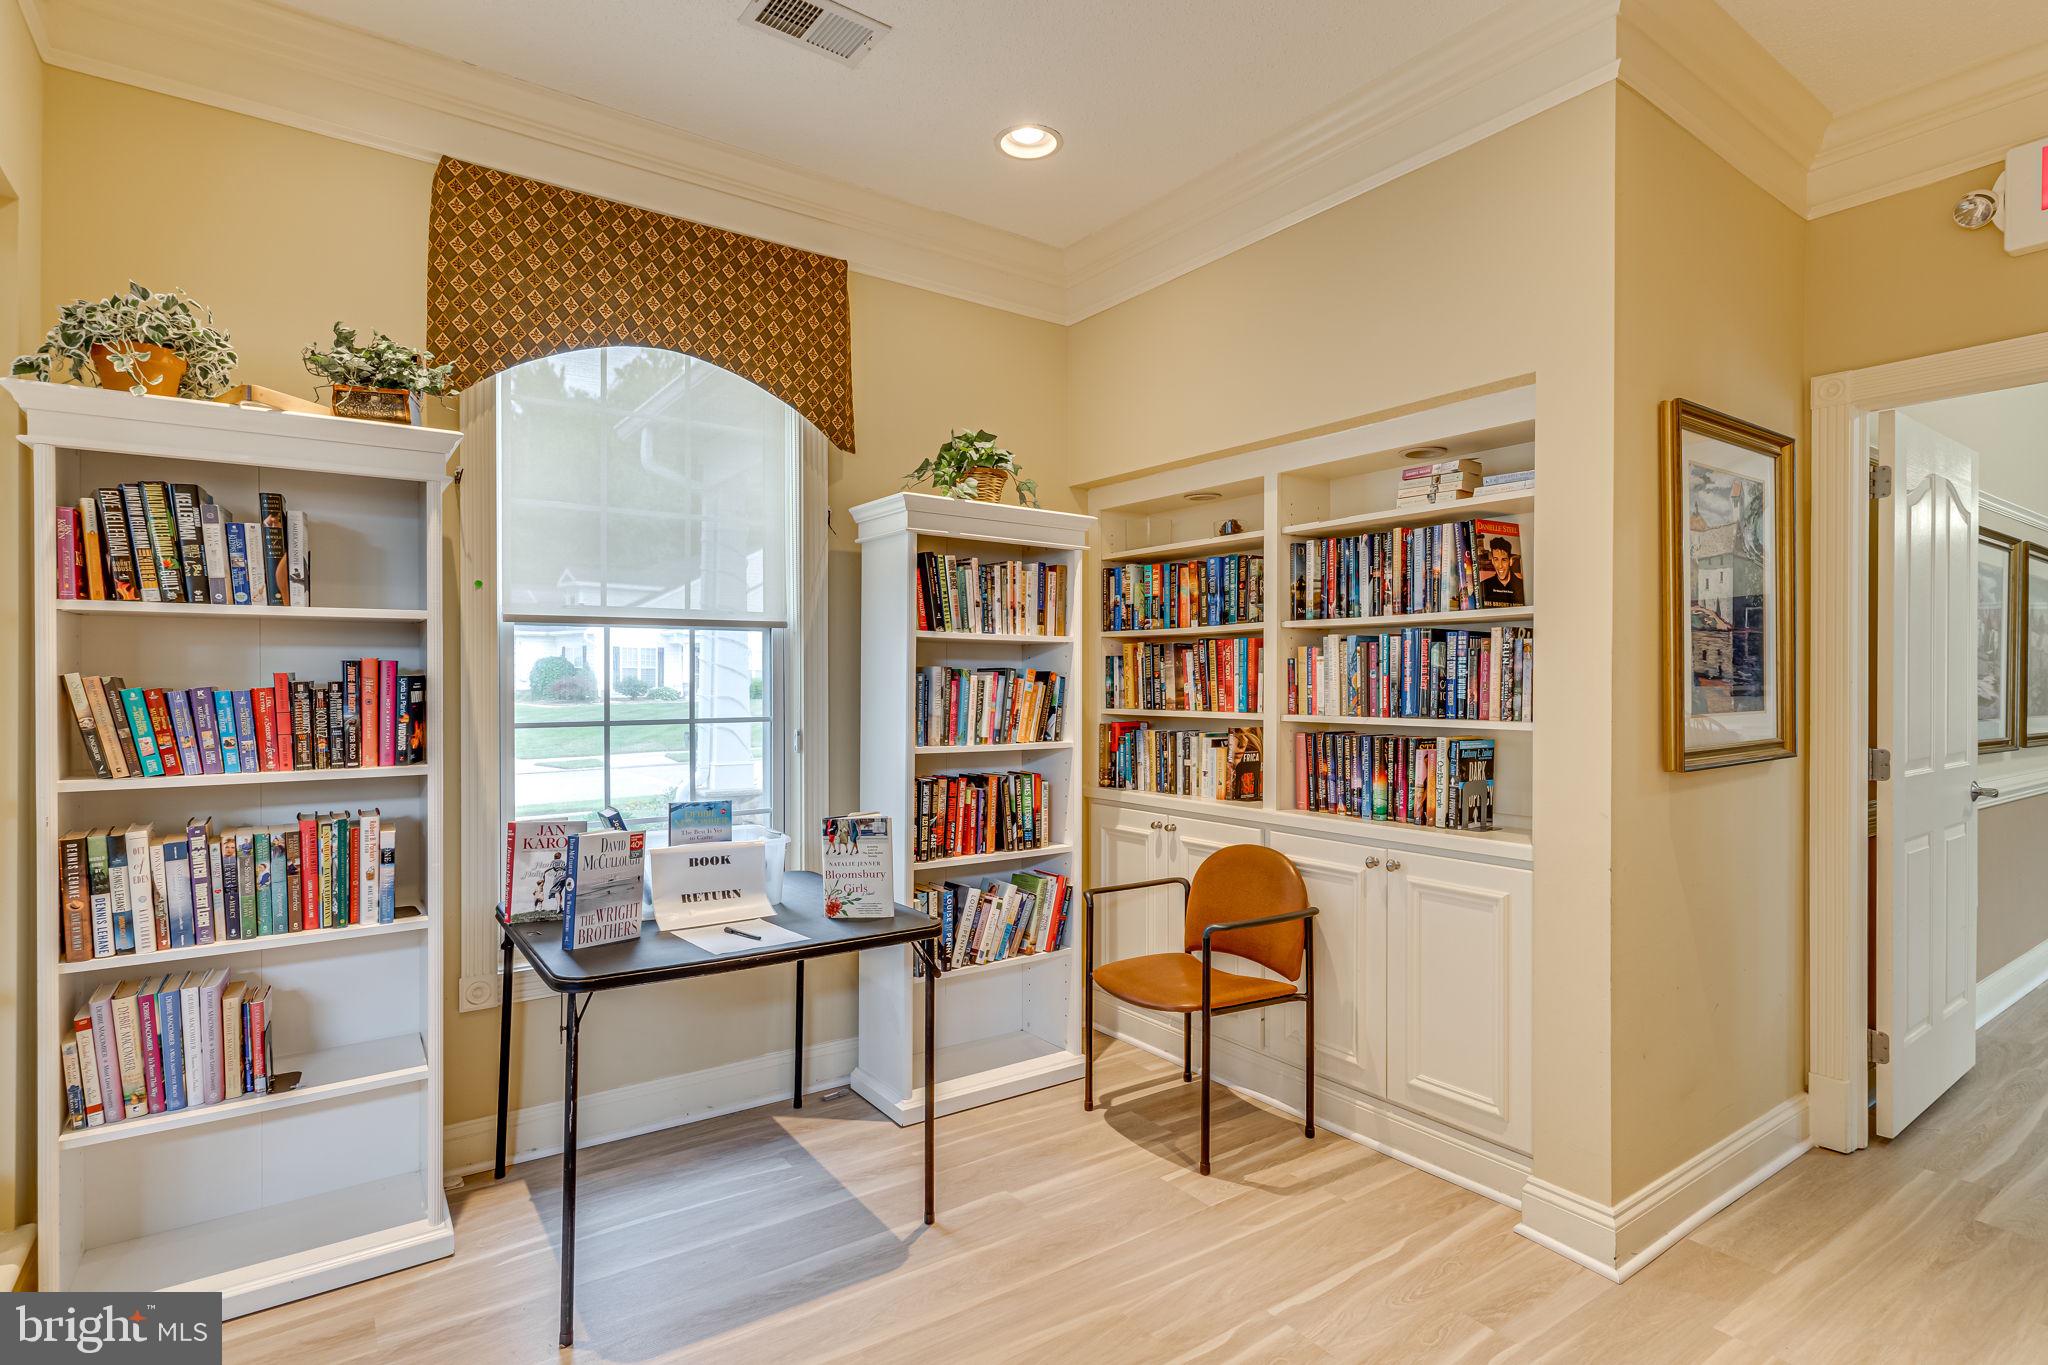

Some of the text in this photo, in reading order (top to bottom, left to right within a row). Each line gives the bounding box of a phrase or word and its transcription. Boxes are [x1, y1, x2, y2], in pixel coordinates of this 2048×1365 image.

[99, 490, 129, 557] FAYE KELLERMAN
[123, 485, 151, 549] JONATHAN KELLERMAN
[144, 483, 175, 556] JONATHAN KELLERMAN
[175, 492, 197, 541] KELLERMAN
[192, 506, 202, 528] JONATHAN
[1477, 521, 1502, 532] DANIELLE
[159, 569, 180, 591] GUILT
[948, 571, 959, 590] INFLUENCE
[1206, 564, 1217, 594] NORA ROBERTS
[918, 598, 926, 617] MALLERY
[1403, 639, 1412, 668] Generals
[1421, 638, 1430, 667] Generals
[1502, 643, 1510, 665] RUN
[399, 677, 407, 692] Lynda
[1007, 670, 1015, 683] Killing
[1420, 675, 1430, 691] Gray
[1457, 656, 1466, 700] BLACK WIDOW
[109, 690, 120, 709] orphan
[347, 665, 356, 713] JAYNE ANN KRENTZ
[400, 692, 408, 700] La
[259, 691, 267, 713] KLEYPAS
[149, 707, 161, 732] MURDER
[175, 708, 184, 732] MURDER
[197, 706, 205, 728] MURDER
[239, 712, 247, 737] MURDER
[315, 710, 327, 738] KOONTZ
[348, 726, 357, 760] RIVER ROAD
[397, 723, 407, 751] WIDOWS
[88, 734, 102, 763] KINGSBURY
[205, 751, 213, 765] KLEIN
[209, 750, 217, 764] LIBBY
[1468, 761, 1487, 782] DARK
[922, 796, 930, 815] PATTERSON
[1023, 777, 1034, 829] JAMES PATTERSON
[1435, 788, 1444, 809] People
[537, 824, 566, 836] JAN
[713, 827, 723, 835] Yet
[921, 815, 930, 826] ALEX
[523, 838, 569, 850] KARO
[601, 837, 626, 853] DAVID
[190, 834, 208, 879] THE SWITCH
[688, 854, 732, 868] BOOK
[66, 843, 81, 899] DENNIS LEHANE
[112, 867, 124, 889] DENNIS
[825, 869, 886, 881] Bloomsbury
[292, 885, 300, 912] Tinderbox
[680, 888, 742, 904] RETURN
[843, 883, 869, 893] Girls
[114, 890, 126, 913] LEHANE
[580, 902, 640, 927] THE WRIGHT
[956, 894, 977, 957] LOUISE PENNY
[95, 897, 110, 955] DENNIS LEHANE
[578, 919, 638, 945] BROTHERS
[945, 894, 953, 959] LOUISE PENNY
[142, 1001, 153, 1051] DEBBIE MACOMBER
[165, 995, 176, 1046] DEBBIE MACOMBER
[186, 993, 197, 1051] DEBBIE MACOMBER
[97, 1025, 107, 1058] MACOMBER
[117, 1006, 136, 1073] DEBBIE MACOMBER
[147, 1056, 155, 1064] It's
[148, 1064, 156, 1077] Better
[149, 1087, 158, 1098] Way
